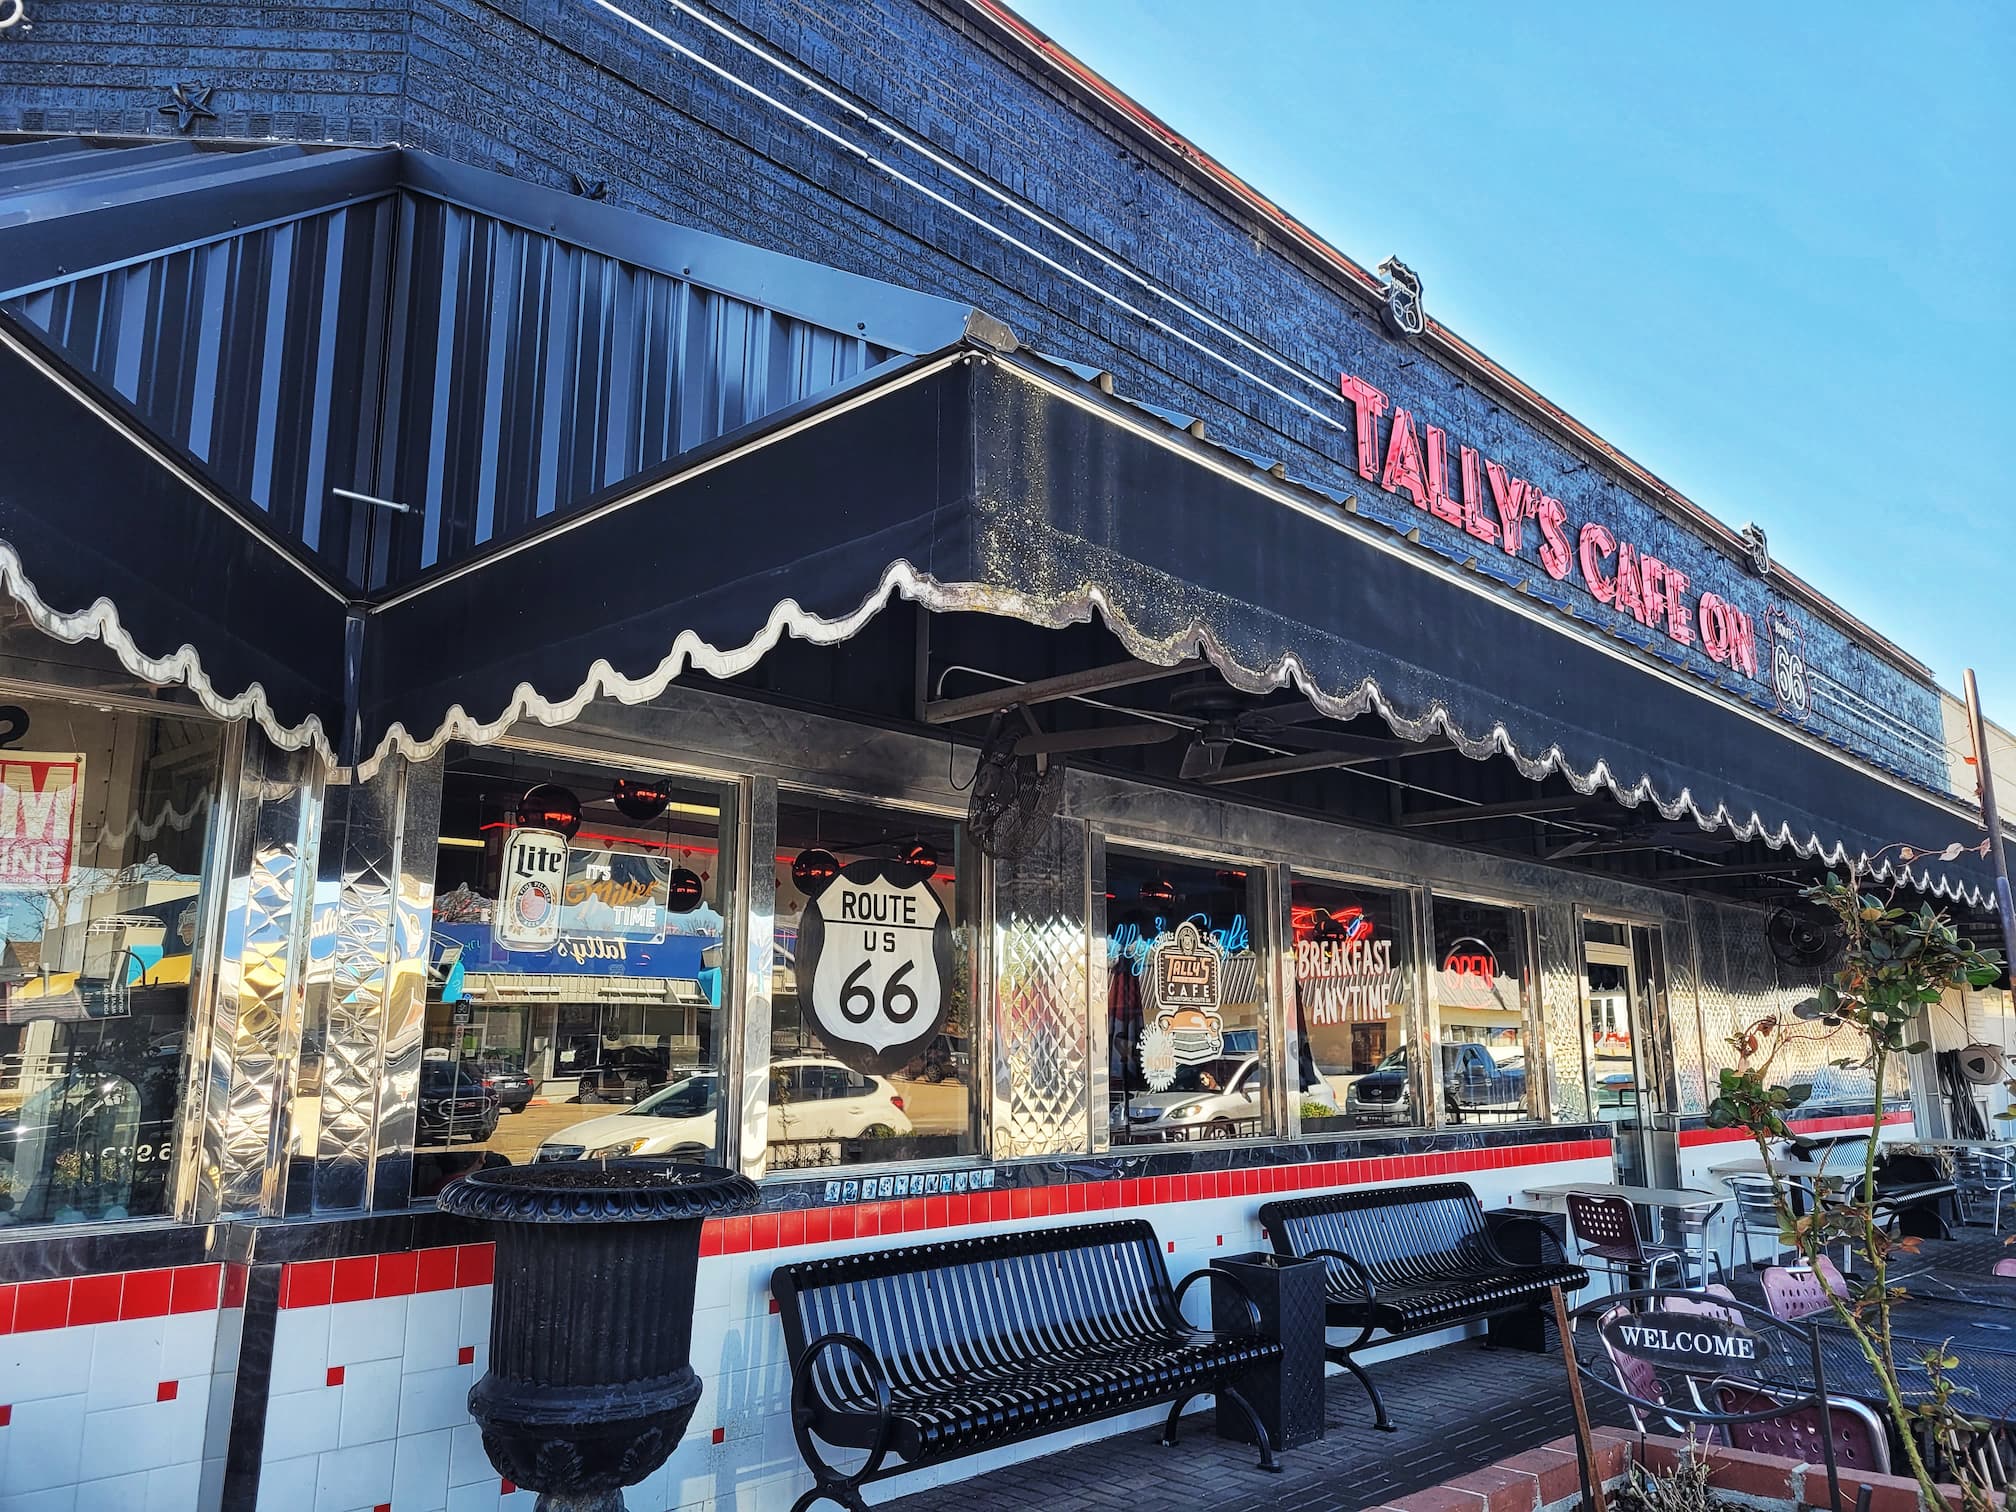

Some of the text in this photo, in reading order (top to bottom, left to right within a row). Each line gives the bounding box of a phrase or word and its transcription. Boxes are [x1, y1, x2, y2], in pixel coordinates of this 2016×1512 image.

[1341, 373, 1757, 679] TALLY'S CAFE ON
[1774, 620, 1796, 644] ROUTE
[1775, 645, 1806, 710] 66
[0, 765, 74, 839] M
[515, 844, 562, 878] Lite
[585, 863, 612, 881] IT'S
[565, 878, 661, 907] Miller
[842, 890, 916, 924] ROUTE
[613, 905, 657, 927] TIME
[864, 930, 896, 952] US
[1164, 954, 1213, 985] TALLY'S
[1298, 939, 1392, 979] BREAKFAST
[1446, 955, 1494, 990] OPEN
[839, 958, 918, 1024] 66
[1167, 982, 1211, 998] CAFE
[1313, 983, 1392, 1025] ANYTIME
[1618, 1325, 1756, 1360] WELCOME
